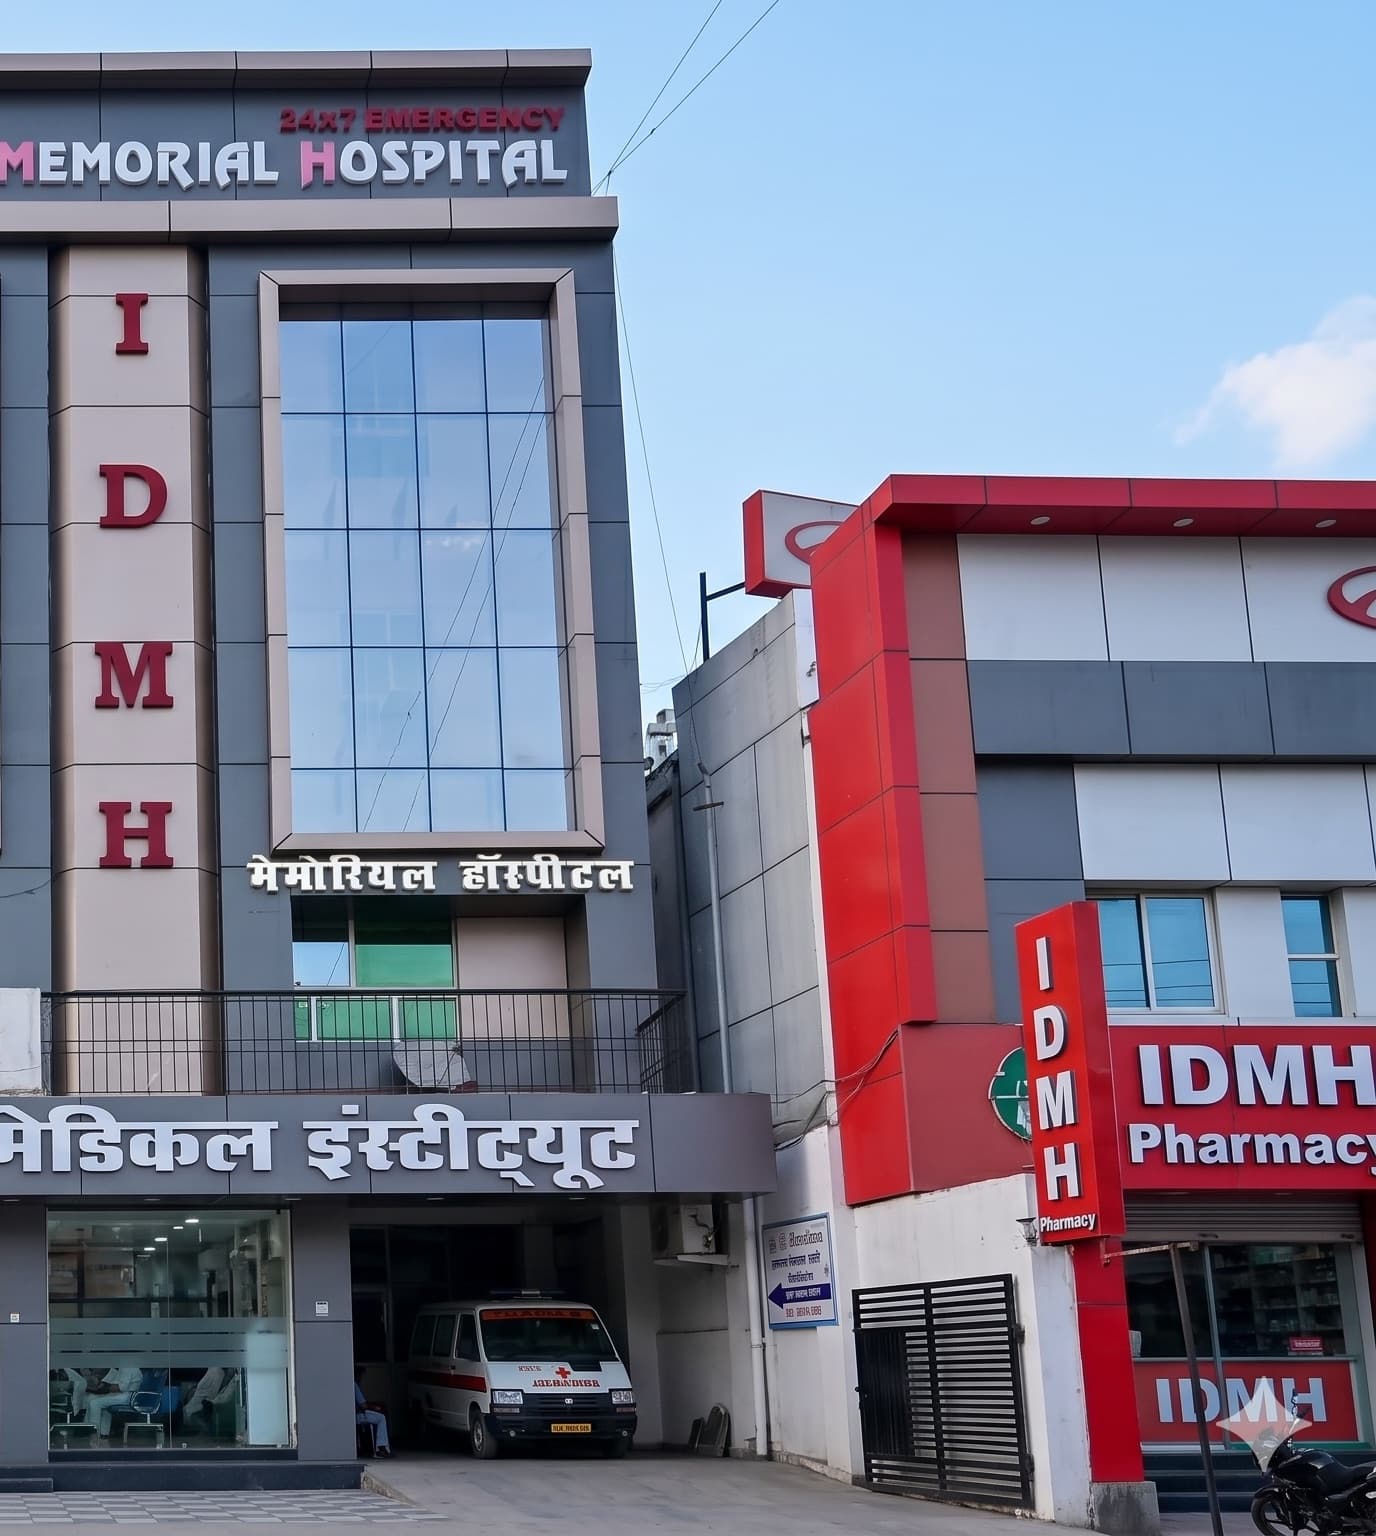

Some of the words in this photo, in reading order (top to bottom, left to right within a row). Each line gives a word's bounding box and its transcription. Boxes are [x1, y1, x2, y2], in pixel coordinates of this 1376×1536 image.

[364, 107, 566, 133] EMERGENCY
[300, 138, 568, 189] HOSPITAL
[246, 854, 438, 893] मेमोरियल
[1138, 1044, 1376, 1106] IDMH
[1039, 1213, 1096, 1233] Pharmacy
[1155, 1377, 1327, 1423] IDMH
